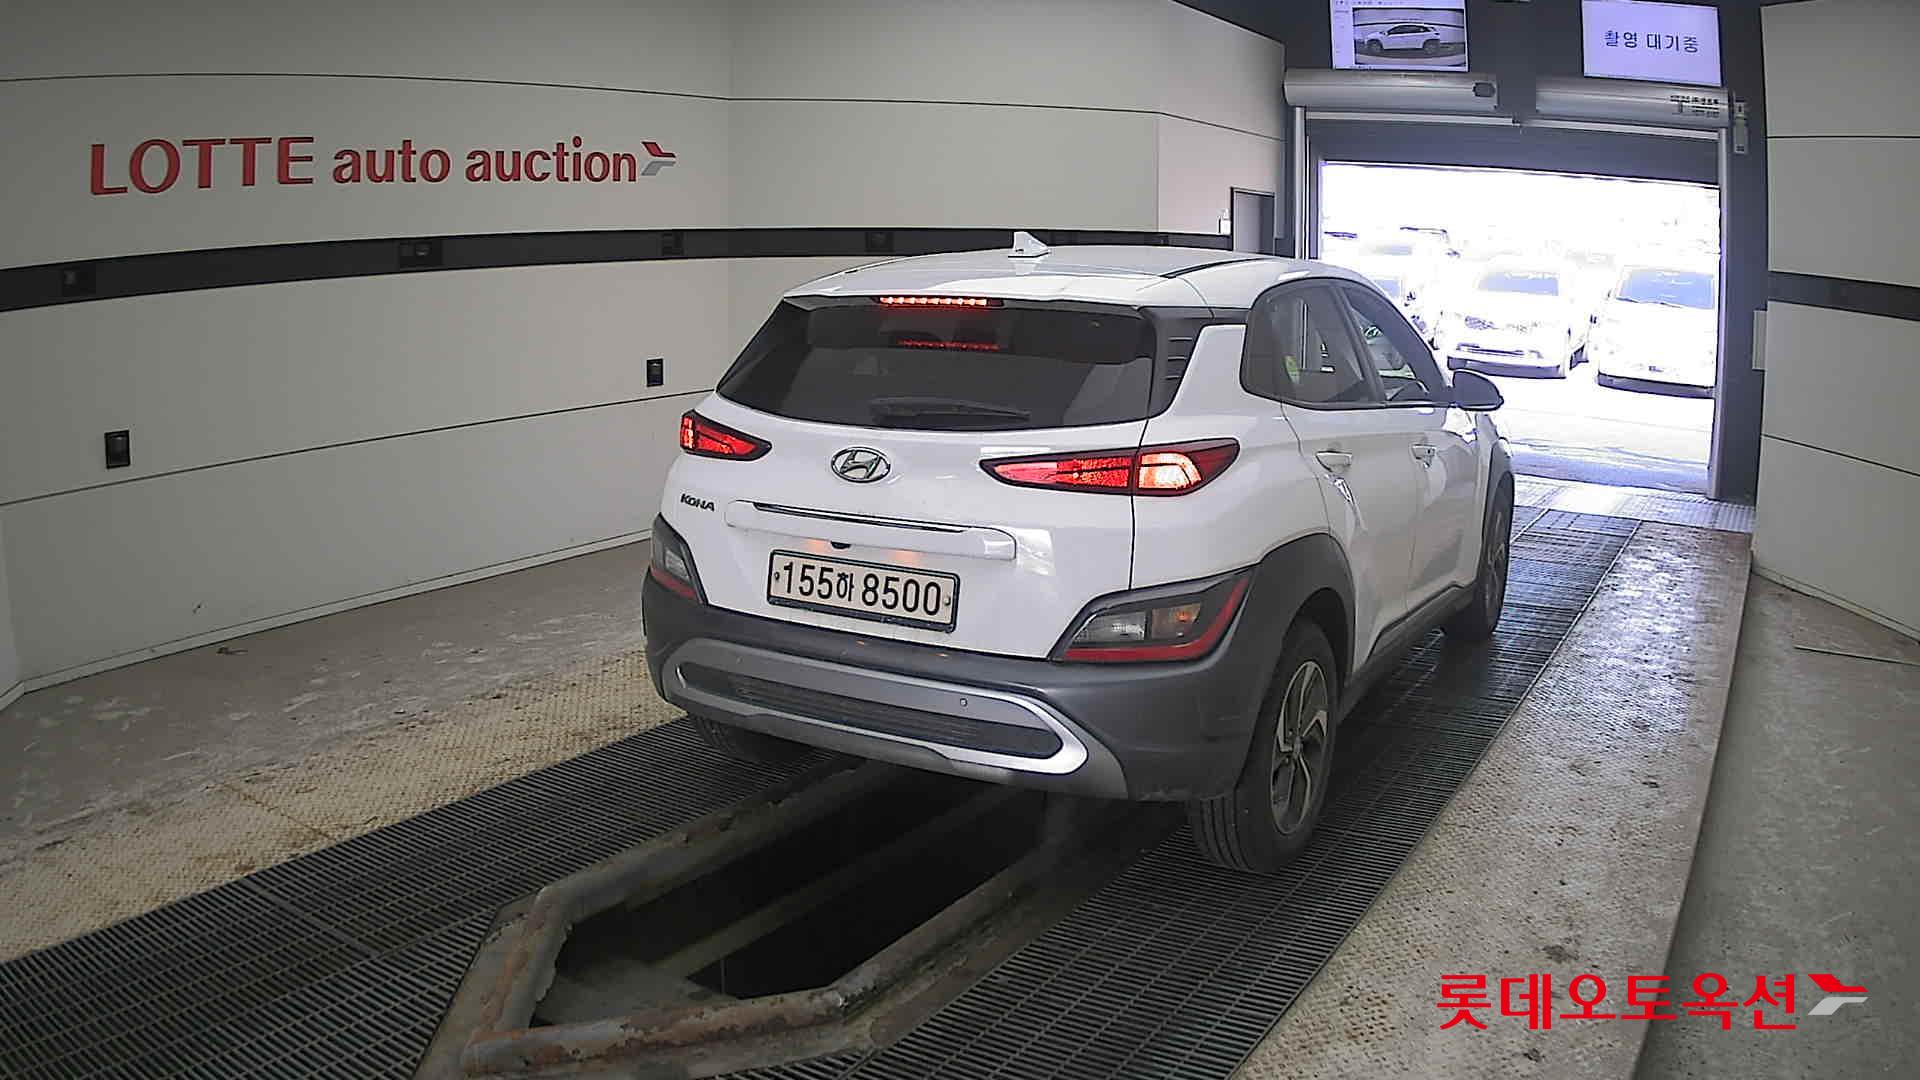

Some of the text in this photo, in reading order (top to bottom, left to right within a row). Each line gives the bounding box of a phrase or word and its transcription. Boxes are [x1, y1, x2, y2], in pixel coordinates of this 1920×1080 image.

[1604, 30, 1699, 53] 촬영 대기중
[91, 136, 637, 196] LOTTE auto auction
[680, 493, 715, 512] KONA
[783, 561, 942, 616] 155하 8500
